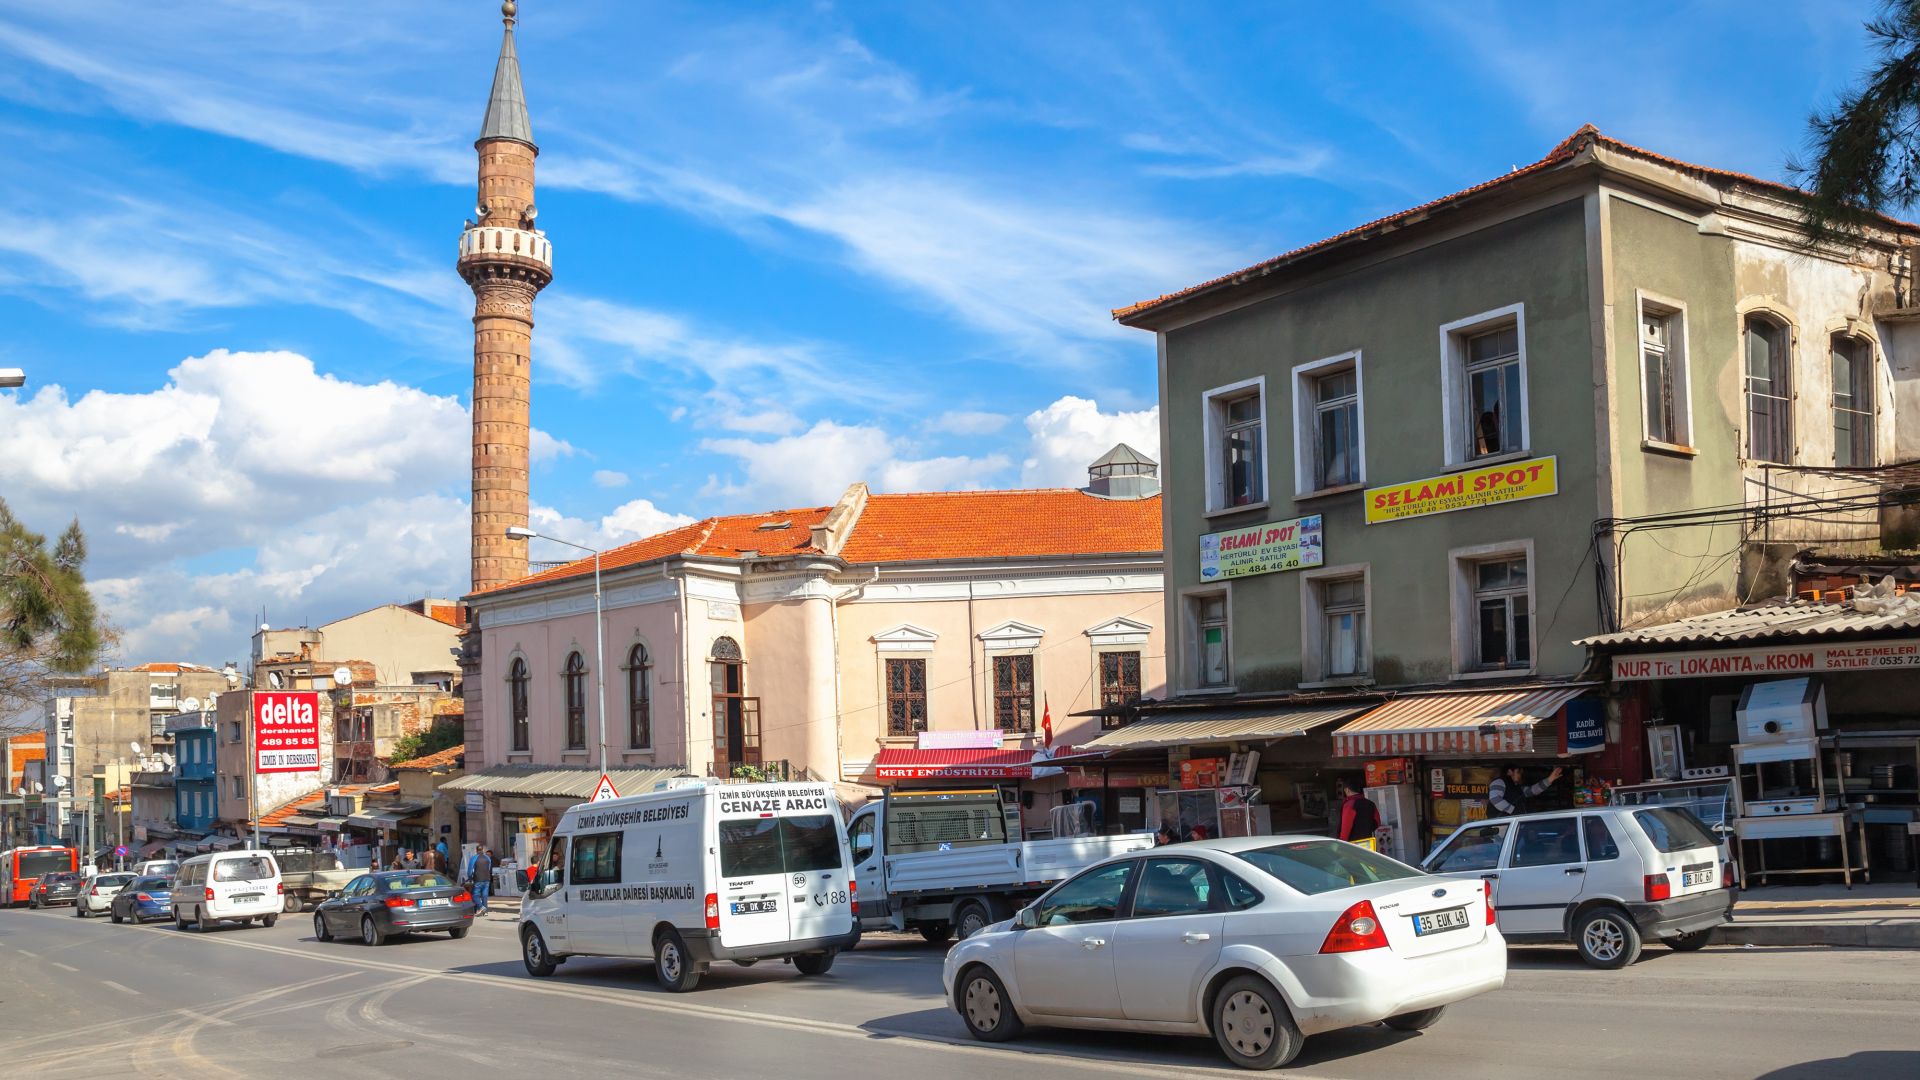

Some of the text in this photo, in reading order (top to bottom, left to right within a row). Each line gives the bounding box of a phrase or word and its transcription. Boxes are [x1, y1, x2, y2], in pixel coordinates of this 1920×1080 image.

[1374, 464, 1544, 510] SELAMİ SPOT
[1466, 490, 1492, 500] ALINIR
[1446, 500, 1467, 508] 0532
[1220, 526, 1295, 551] SELAMİ SPOT
[1220, 550, 1257, 560] HERTÜRLÜ
[1273, 544, 1298, 552] EŞYASI
[1230, 558, 1254, 566] ALINIR
[1260, 552, 1286, 562] SATILIR
[1222, 568, 1245, 576] TEL:
[1248, 564, 1267, 573] 484
[1826, 645, 1917, 658] MALZEMELERİ
[1618, 652, 1814, 678] NUR Tic. LOKANTA ve KROM
[1826, 658, 1868, 668] SATILIR
[261, 696, 314, 724] delta
[1576, 718, 1595, 728] KADİR
[1568, 730, 1586, 739] TEKEL
[879, 768, 1006, 777] MERT ENDÜSTRİYEL
[718, 788, 825, 800] İZMİR BÜYÜKŞEHİR BELEDİYESİ
[1446, 784, 1470, 794] TEKEL
[720, 798, 828, 814] CENAZE ARACI
[578, 802, 690, 829] İZMİR BÜYÜKŞEHİR BELEDİYESİ
[794, 876, 805, 884] 59
[1706, 872, 1712, 882] 67
[580, 884, 694, 903] MEZARLIKLAR DAİRESİ BAŞKANLIĞI
[823, 890, 846, 905] 188
[736, 903, 746, 912] 35
[762, 902, 775, 910] 259
[1420, 916, 1432, 930] 35
[1436, 912, 1452, 928] EUK
